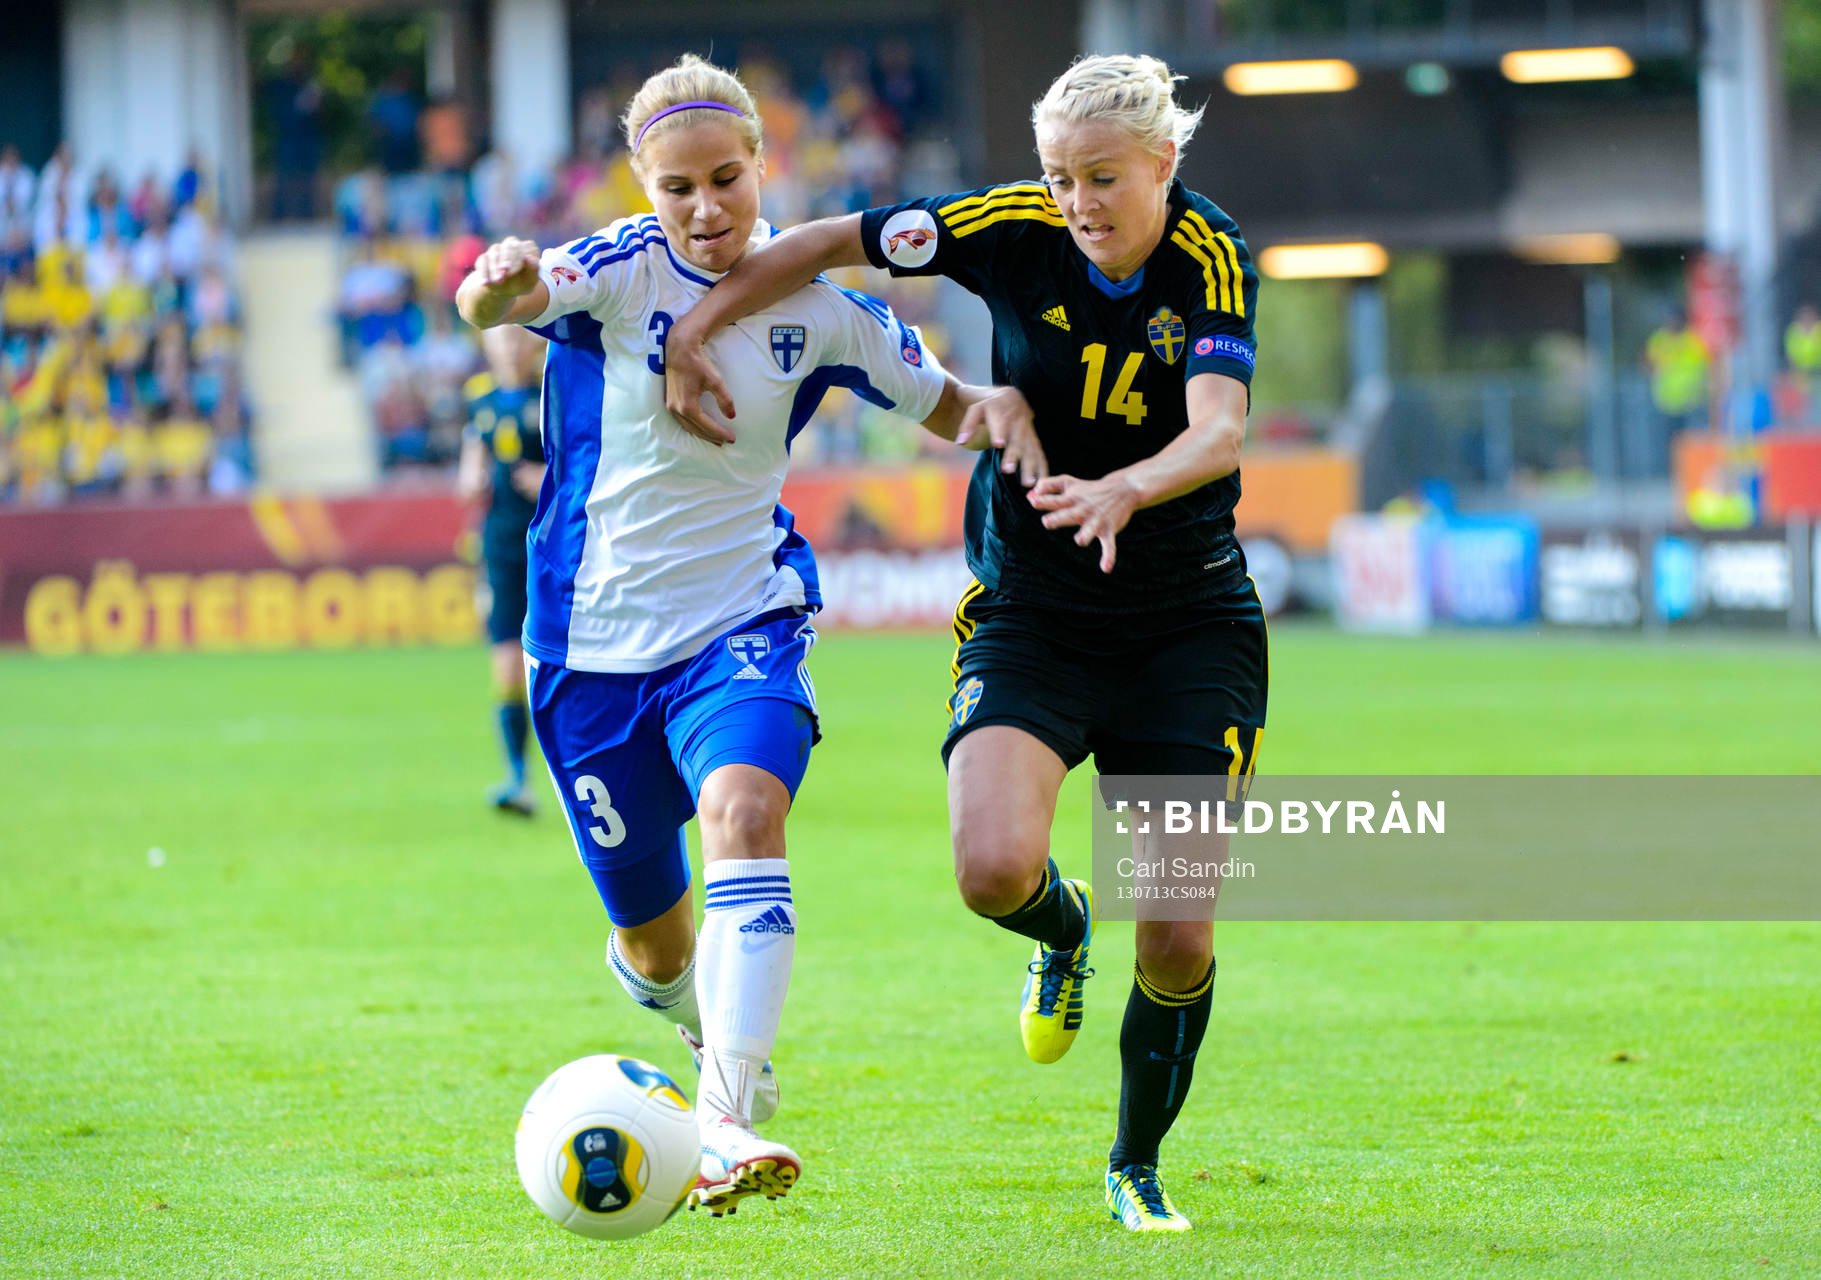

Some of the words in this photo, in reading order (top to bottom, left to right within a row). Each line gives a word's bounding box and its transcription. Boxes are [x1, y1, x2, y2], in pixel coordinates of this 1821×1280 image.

[647, 310, 674, 376] 3
[1041, 312, 1071, 332] adidas
[1215, 340, 1256, 367] RESPEC
[1080, 343, 1148, 426] 14
[24, 559, 480, 657] GÖTEBORG
[574, 774, 627, 848] 3
[739, 922, 795, 935] adidas
